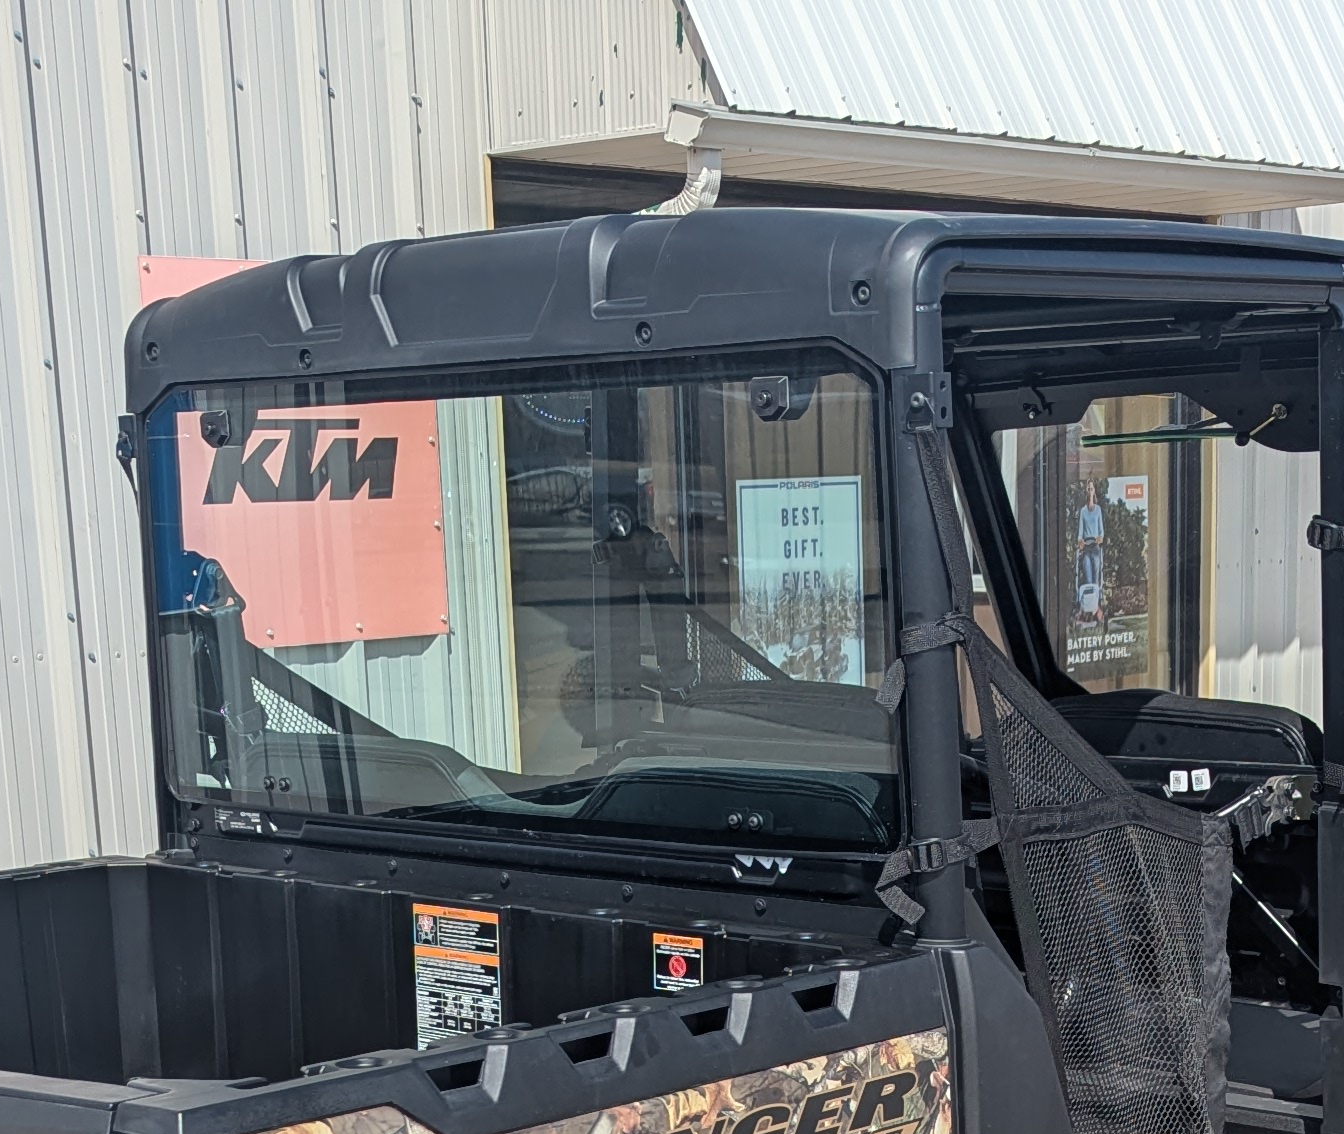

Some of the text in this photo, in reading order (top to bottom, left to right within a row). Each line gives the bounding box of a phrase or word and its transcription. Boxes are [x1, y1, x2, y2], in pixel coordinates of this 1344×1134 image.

[202, 417, 399, 505] KTM
[779, 480, 820, 490] POLARIS
[781, 506, 824, 527] BEST.
[783, 539, 823, 559] GIFT.
[782, 570, 826, 593] EVER.
[1067, 632, 1136, 651] BATTERY POWER.
[1067, 651, 1091, 666] MADE
[1093, 649, 1104, 662] BY
